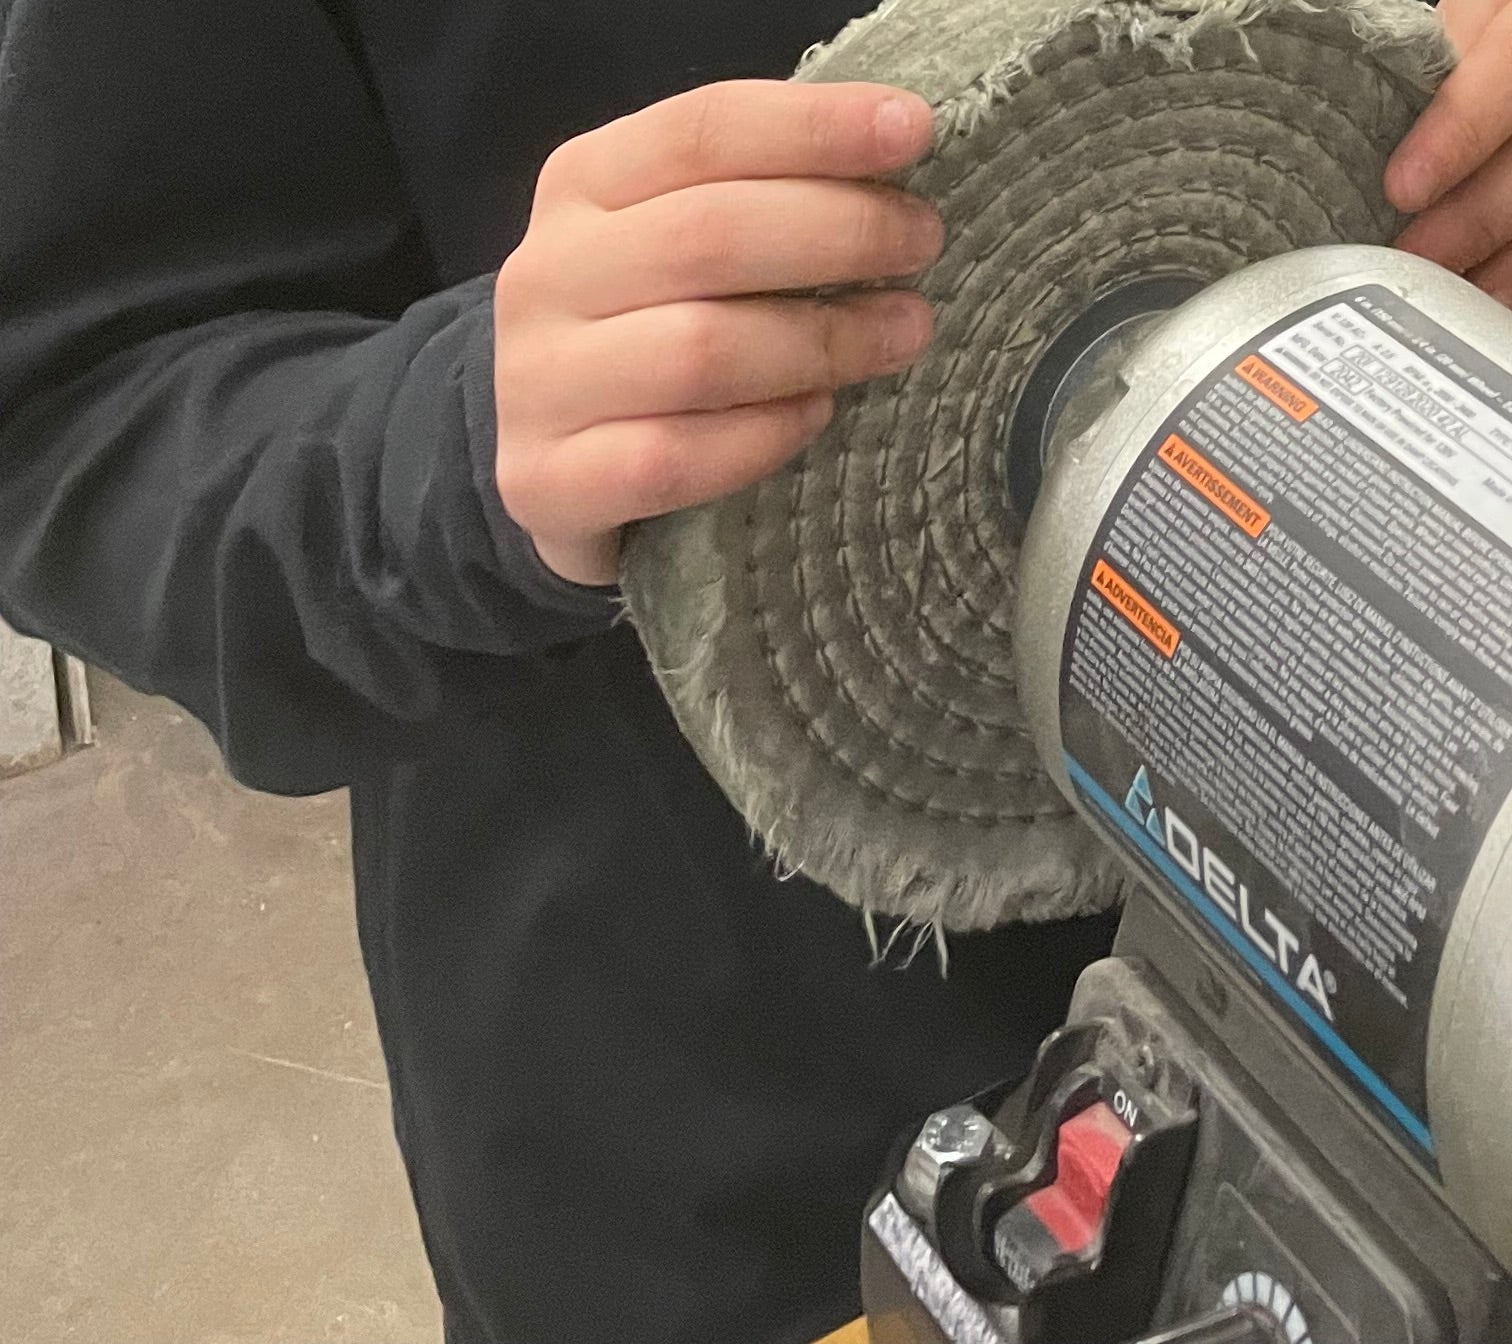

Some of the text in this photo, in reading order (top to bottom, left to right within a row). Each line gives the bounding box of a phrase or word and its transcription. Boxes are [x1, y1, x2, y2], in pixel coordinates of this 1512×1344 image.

[1249, 364, 1306, 415] WARNING
[1171, 448, 1263, 530] AVERTISSEMENT
[1103, 576, 1178, 651] ADVERTENCIA
[1160, 804, 1336, 1023] DELTA
[1113, 1089, 1138, 1128] ON
